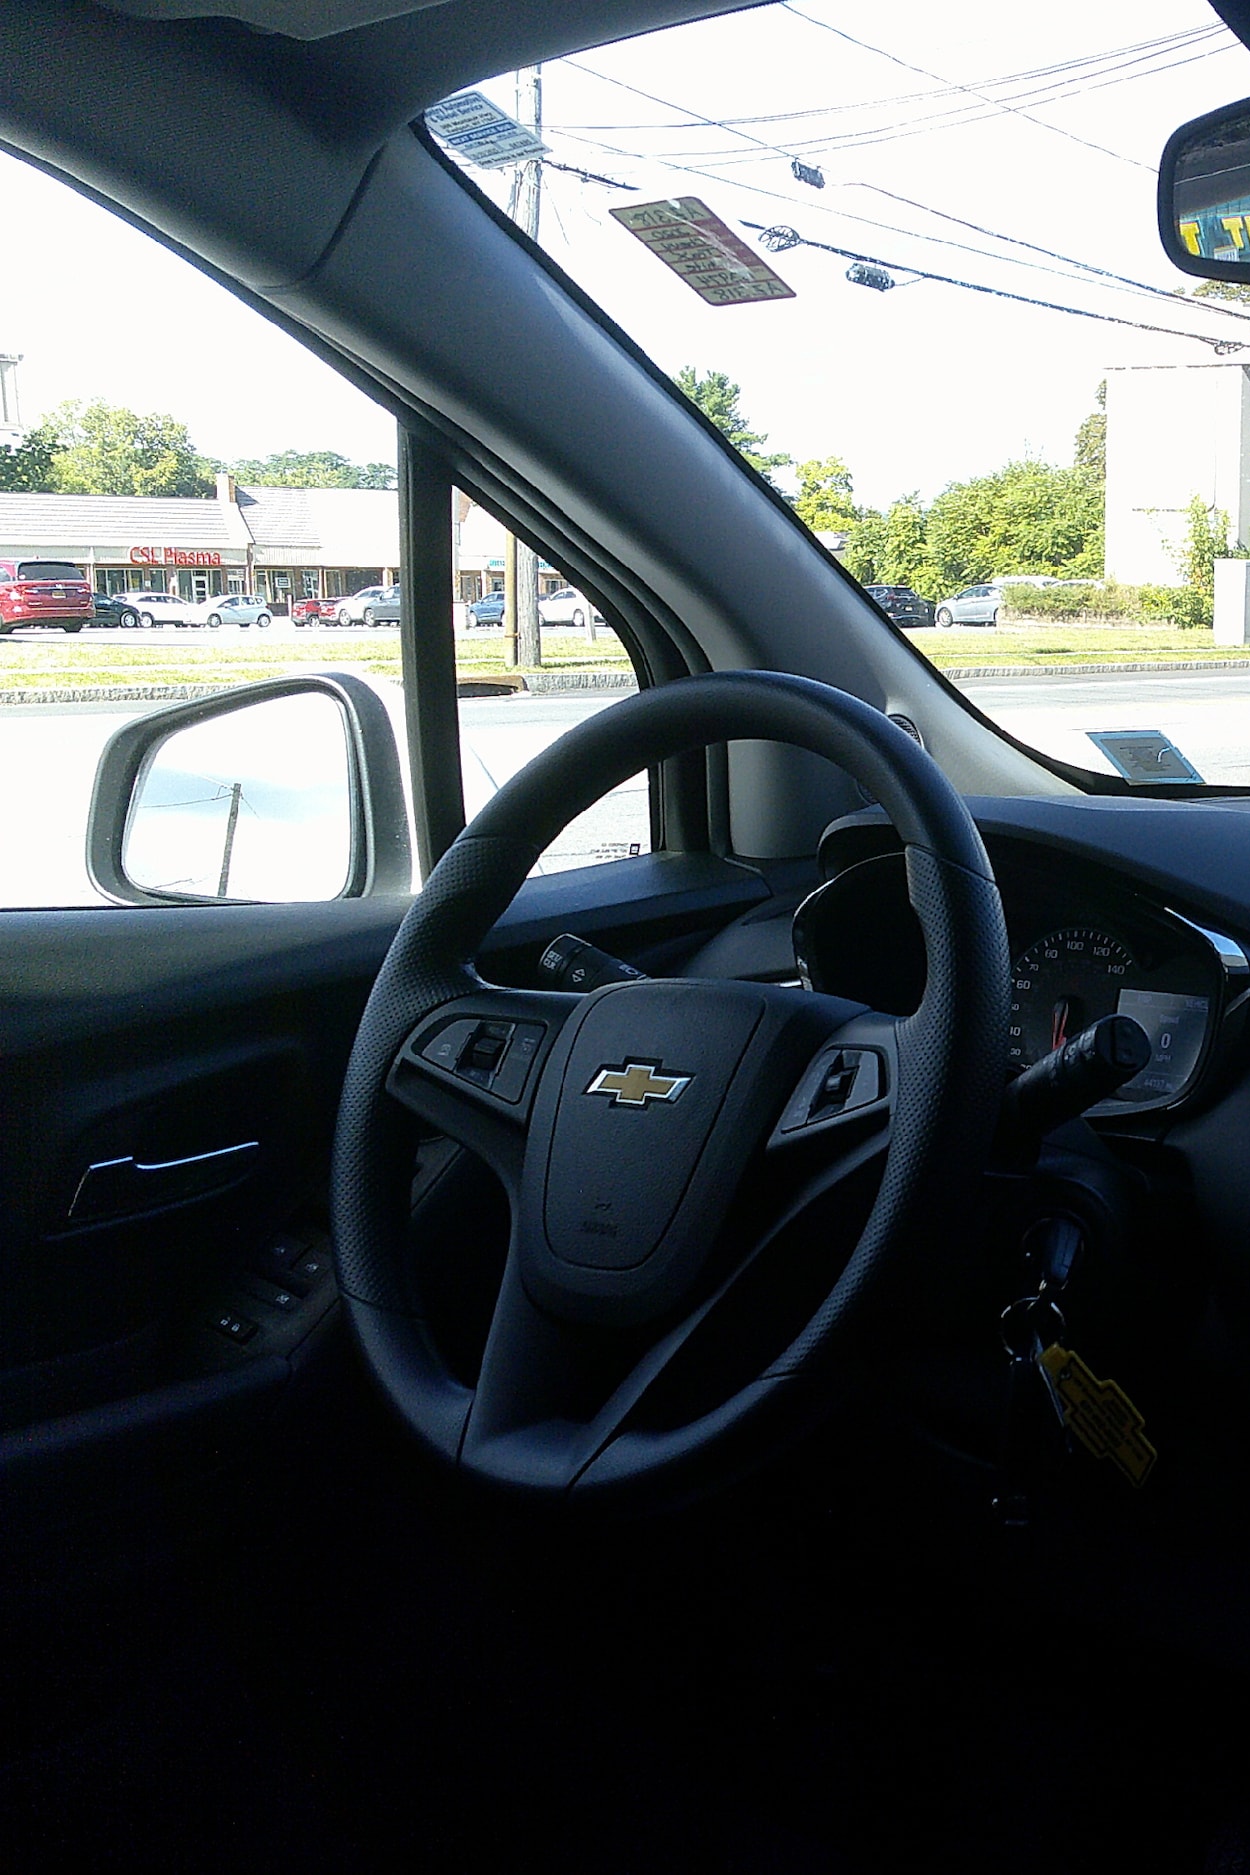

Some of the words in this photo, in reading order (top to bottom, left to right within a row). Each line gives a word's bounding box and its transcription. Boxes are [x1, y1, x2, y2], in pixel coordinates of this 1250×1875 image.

[130, 546, 160, 564] CSL
[163, 547, 221, 566] Plasma
[1067, 940, 1084, 951] 100
[1093, 946, 1111, 957] 120
[1107, 964, 1125, 975] 140
[1016, 979, 1031, 990] 60
[1160, 1033, 1172, 1048] 0
